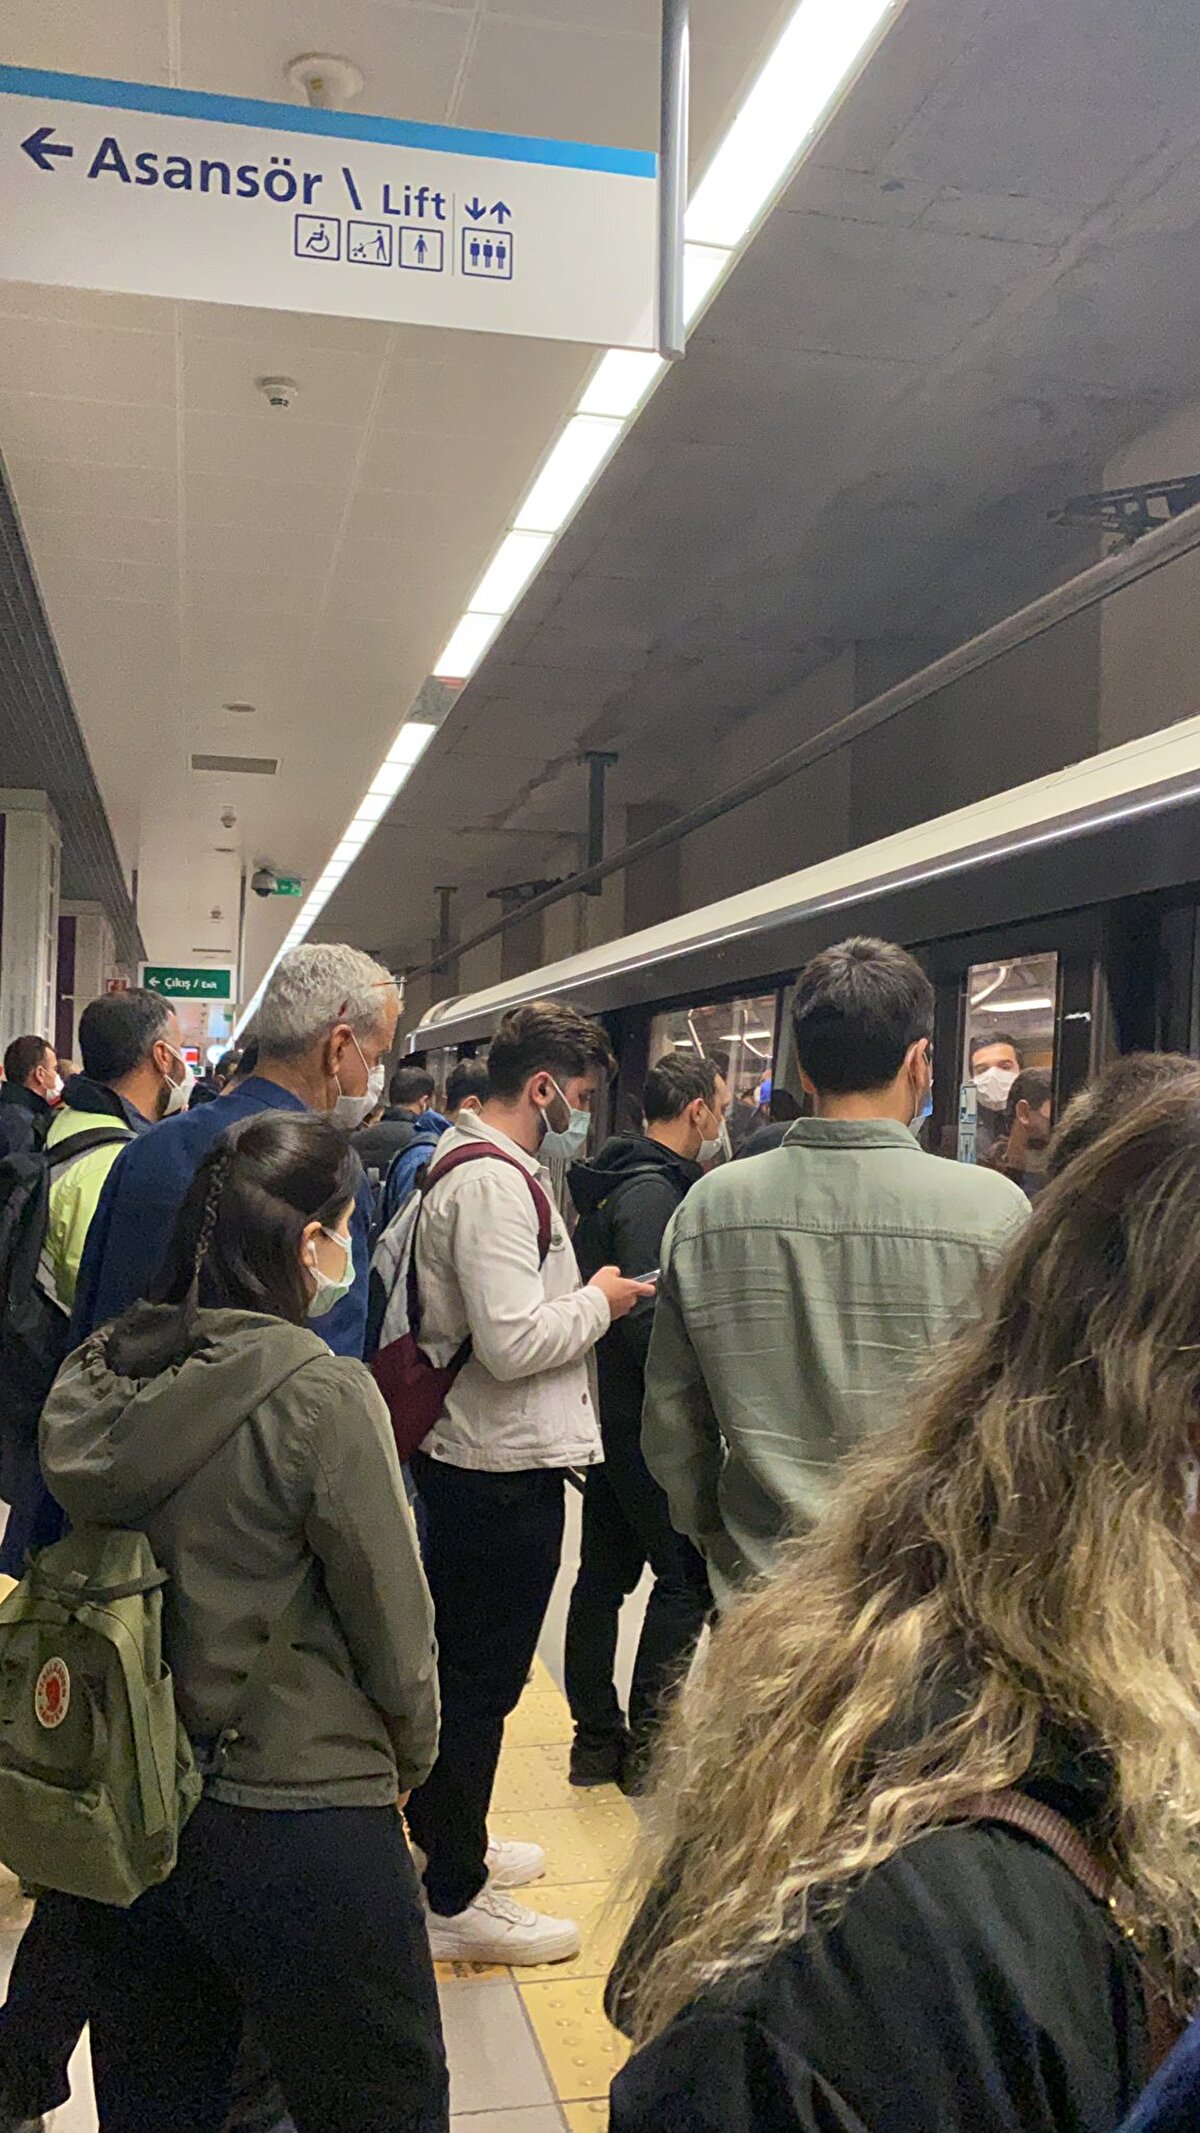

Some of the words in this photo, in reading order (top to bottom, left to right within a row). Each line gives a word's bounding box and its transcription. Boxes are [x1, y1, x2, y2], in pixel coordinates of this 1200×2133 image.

[87, 136, 323, 205] Asansör
[382, 184, 447, 221] Lift
[164, 977, 191, 990] Çıkış
[201, 981, 217, 989] Exit
